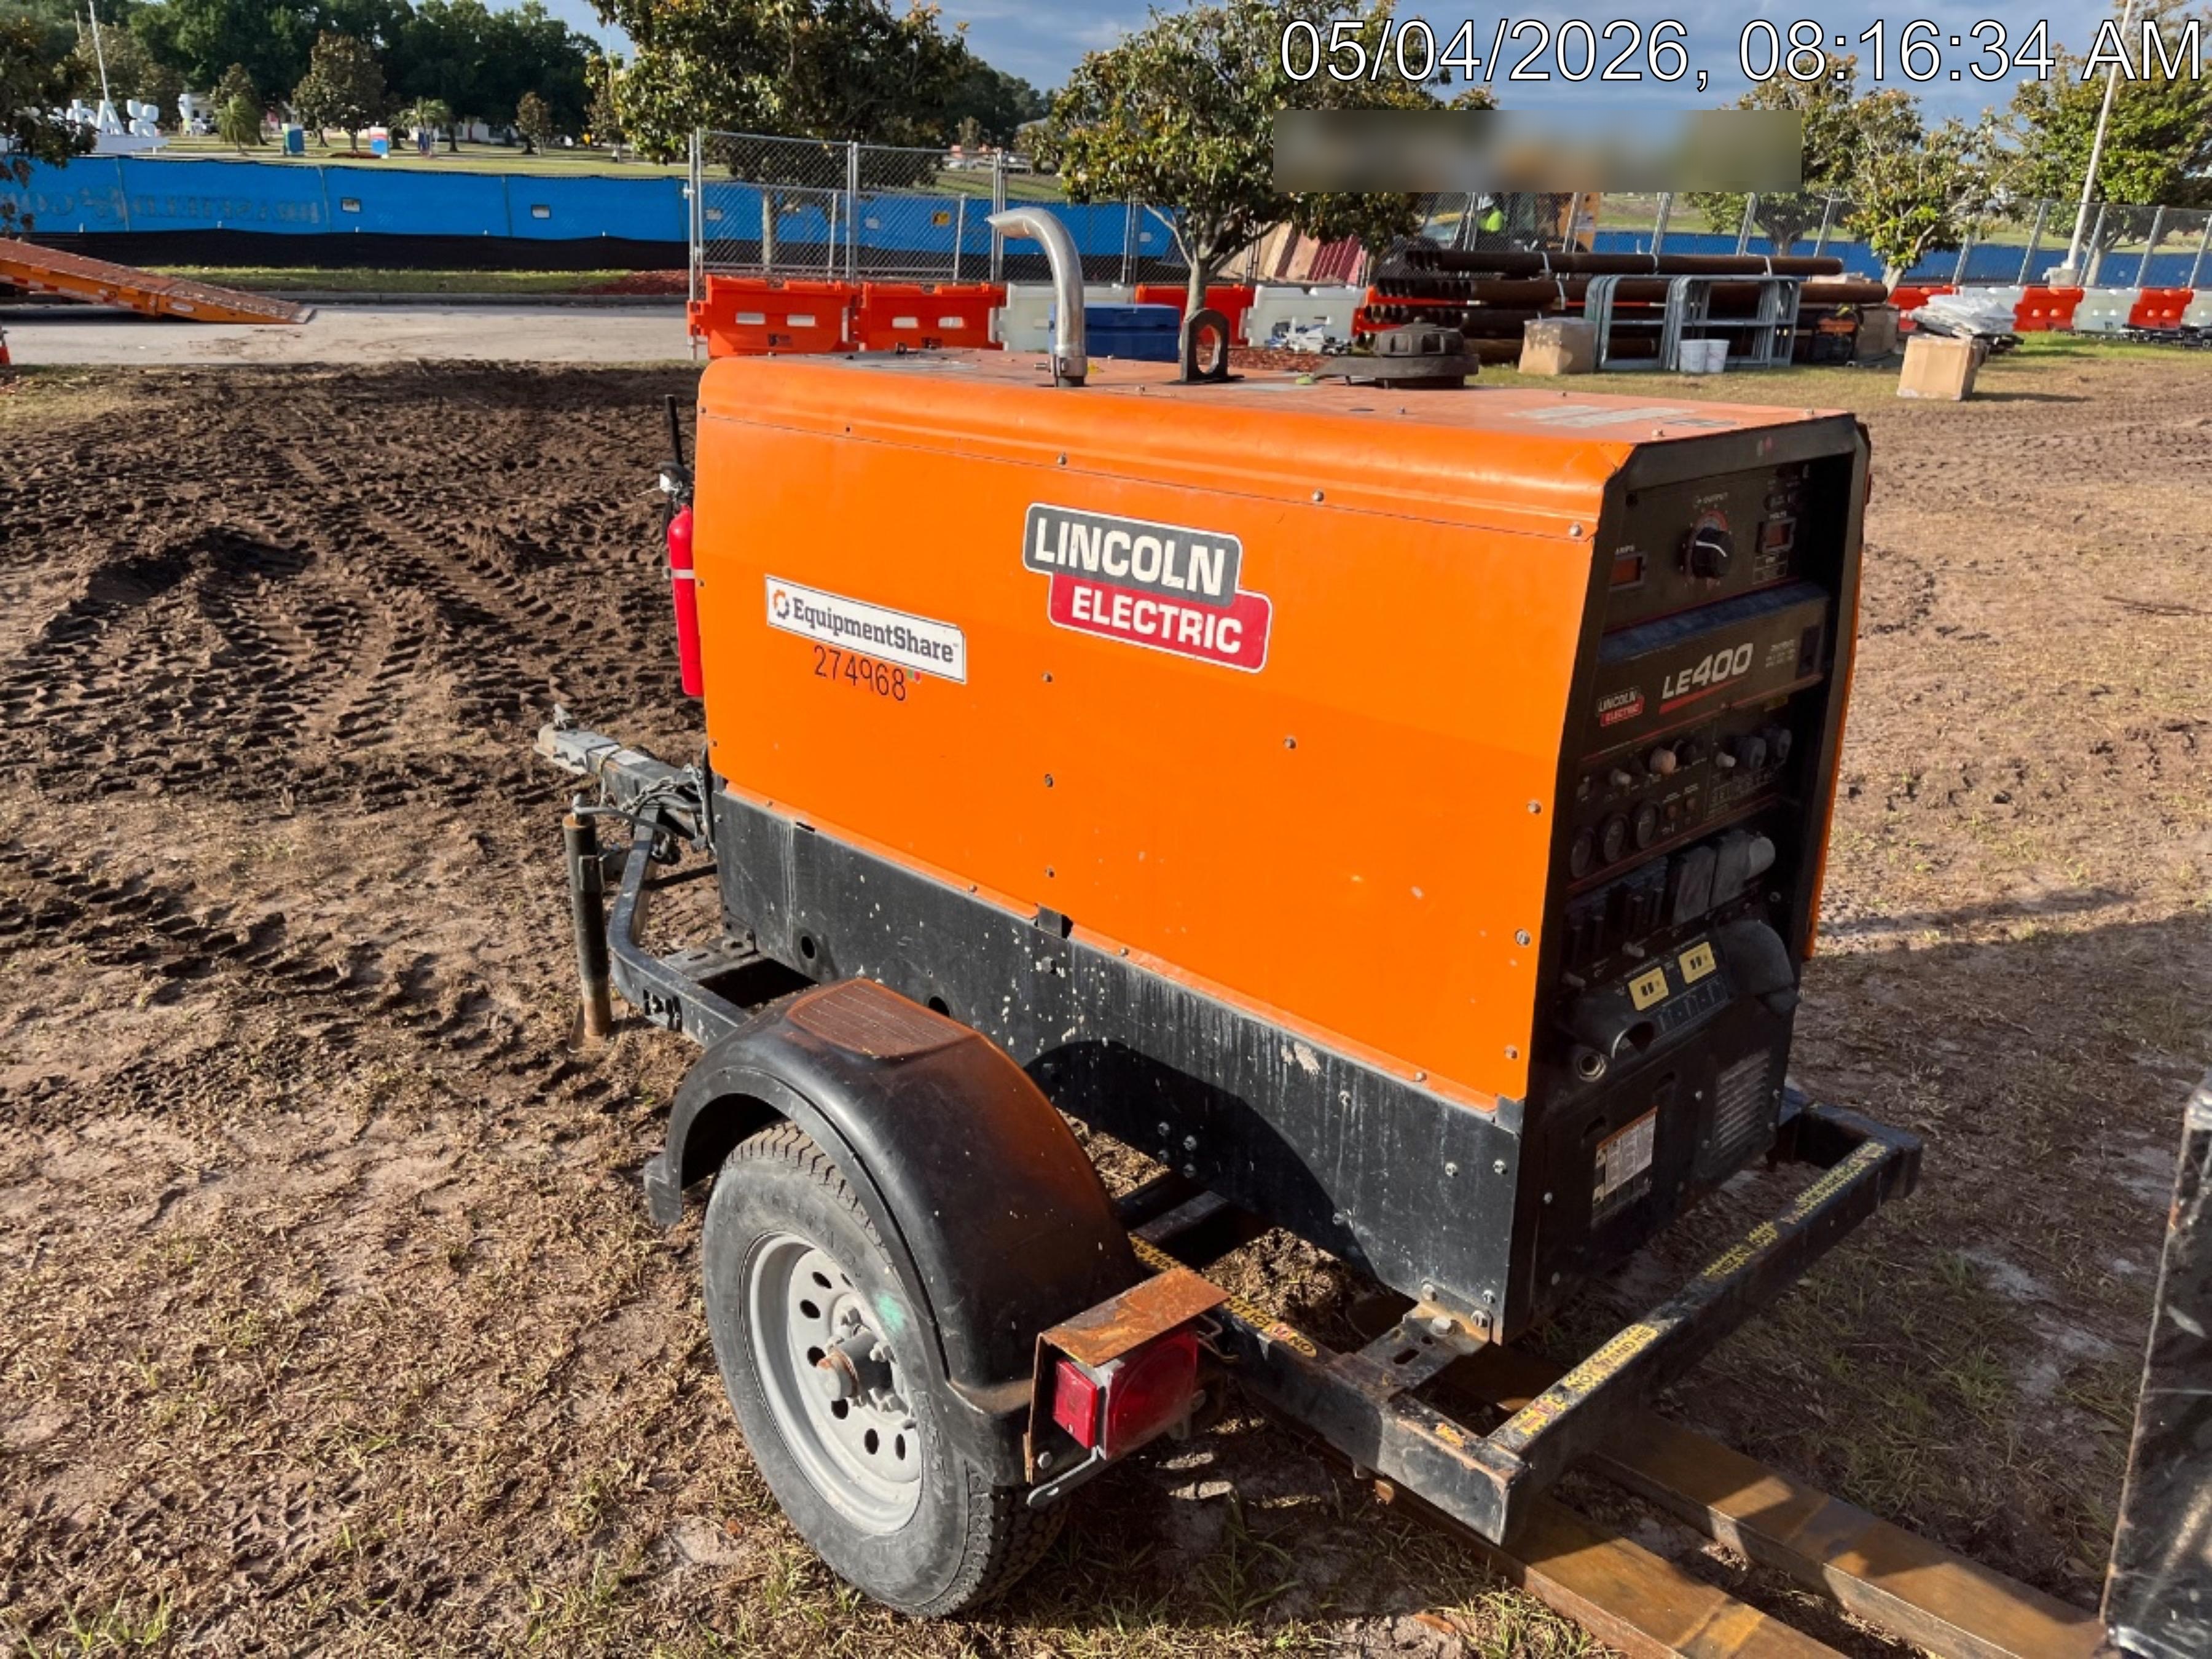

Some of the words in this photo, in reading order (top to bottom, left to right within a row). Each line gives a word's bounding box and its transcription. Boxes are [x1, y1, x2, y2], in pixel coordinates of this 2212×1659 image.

[1035, 517, 1225, 597] LINCOLN
[793, 597, 954, 663] EquipmentShare
[1072, 585, 1243, 654] ELECTRIC
[814, 645, 906, 702] 274968
[1661, 643, 1754, 699] LE400
[1599, 688, 1637, 712] LINCOLN
[1606, 703, 1640, 724] ELECTRIC
